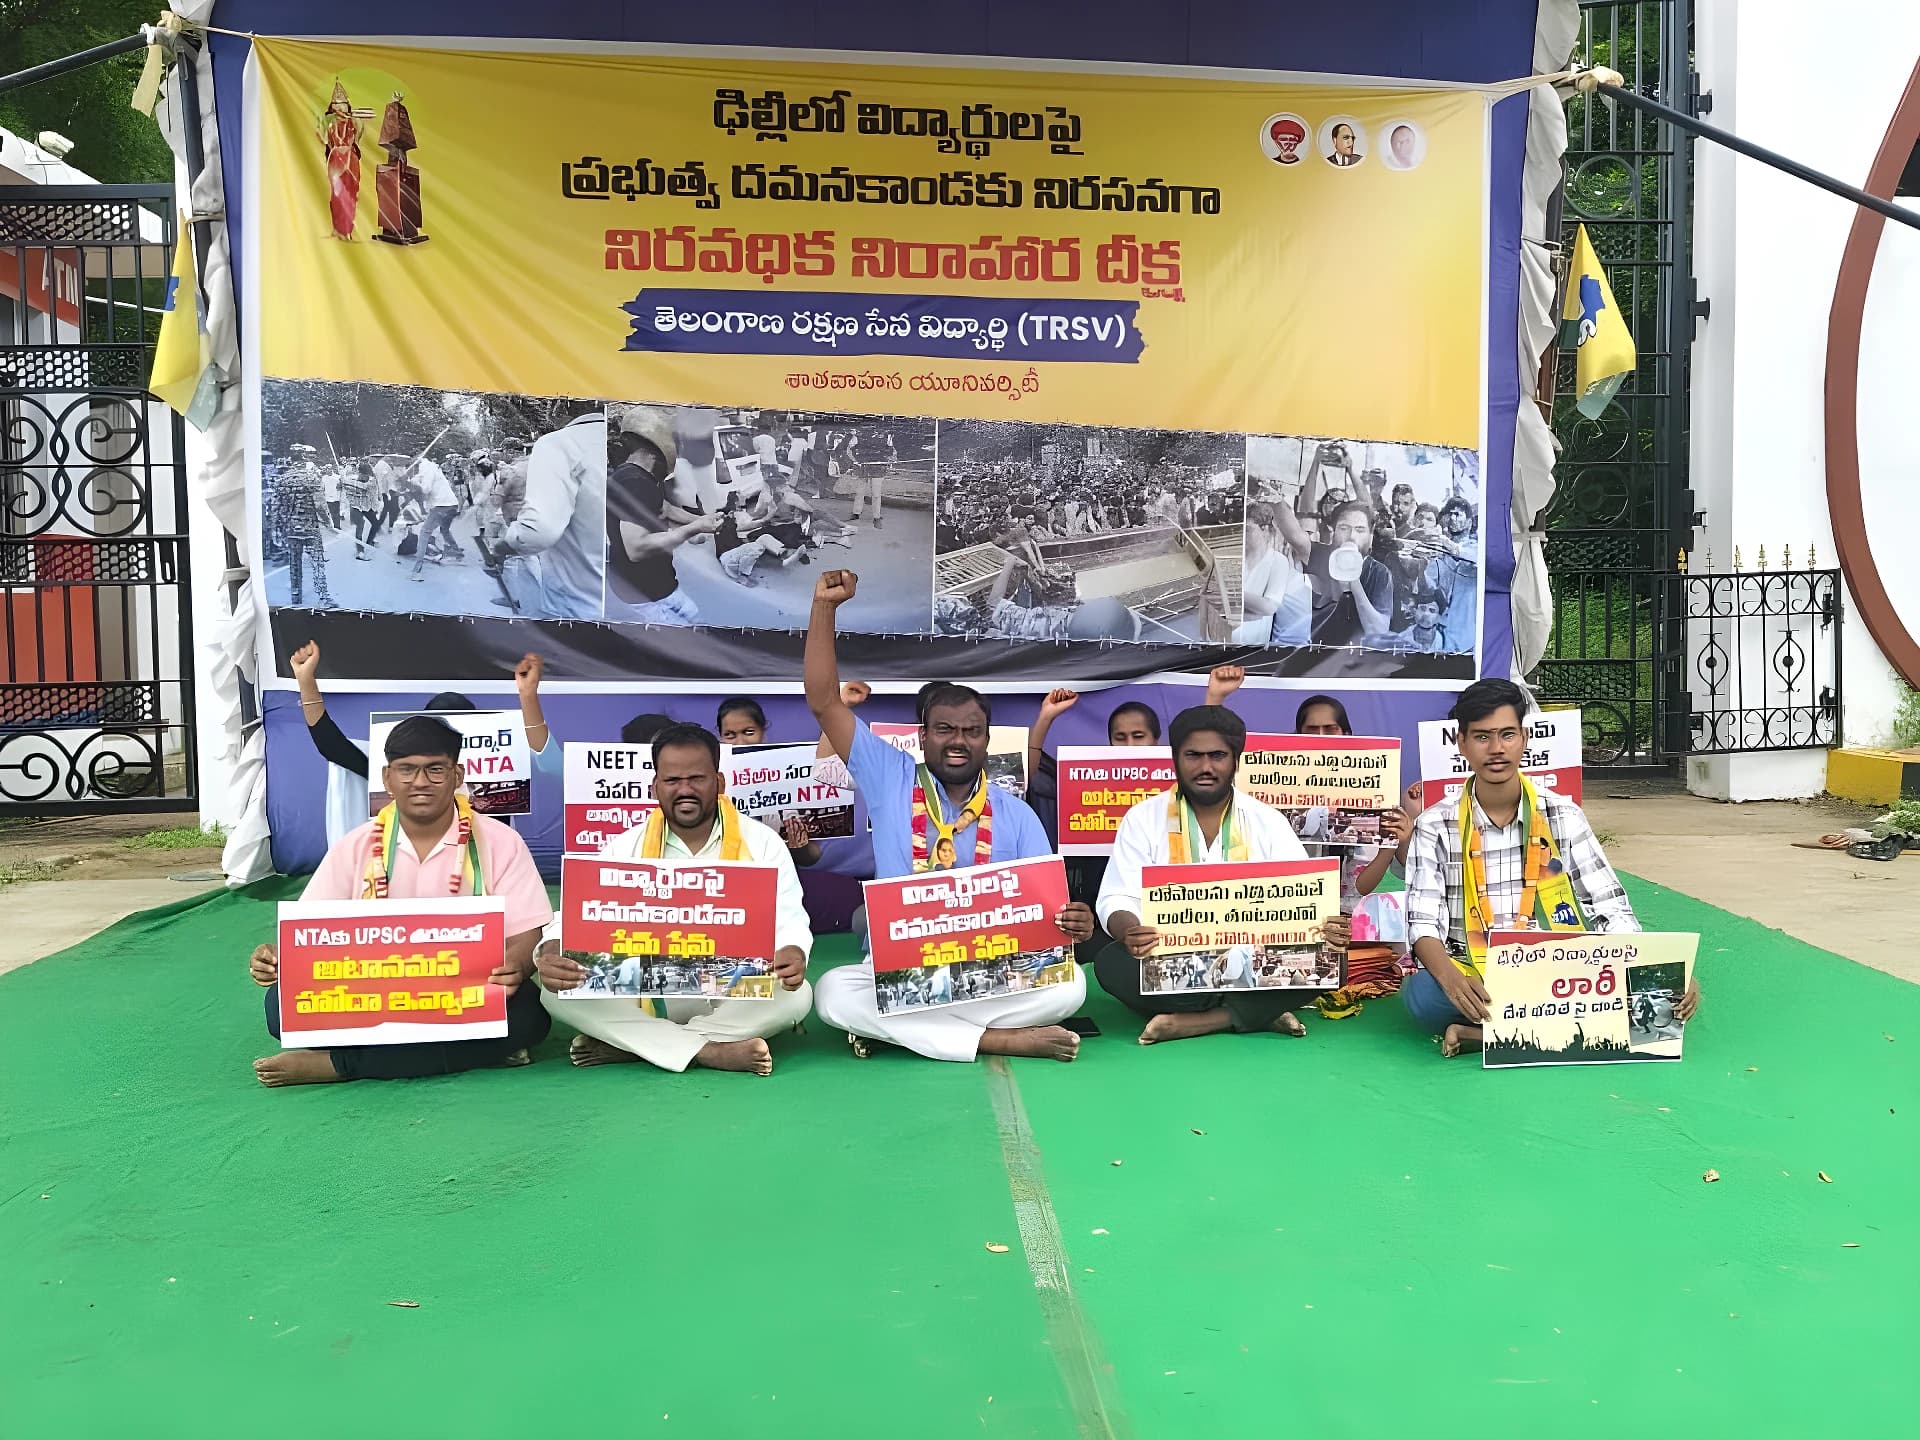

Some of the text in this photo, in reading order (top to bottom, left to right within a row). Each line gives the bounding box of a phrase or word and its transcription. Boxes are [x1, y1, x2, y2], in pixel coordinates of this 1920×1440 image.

[713, 88, 1084, 160] ఢిల్లీలో విద్యార్థులపై
[561, 156, 1221, 215] ప్రభుత్వ దమనకాండకు నిరసనగా
[604, 225, 835, 284] నిరవధిక
[851, 235, 1081, 283] నిరాహార
[654, 306, 1126, 351] తెలంగాణ రక్షణ సేన విద్యార్థి (TRSV)
[466, 756, 515, 776] NTA
[586, 750, 639, 770] NEET
[594, 778, 642, 799] పేపర్
[797, 785, 840, 802] NTA
[355, 926, 407, 945] UPSC
